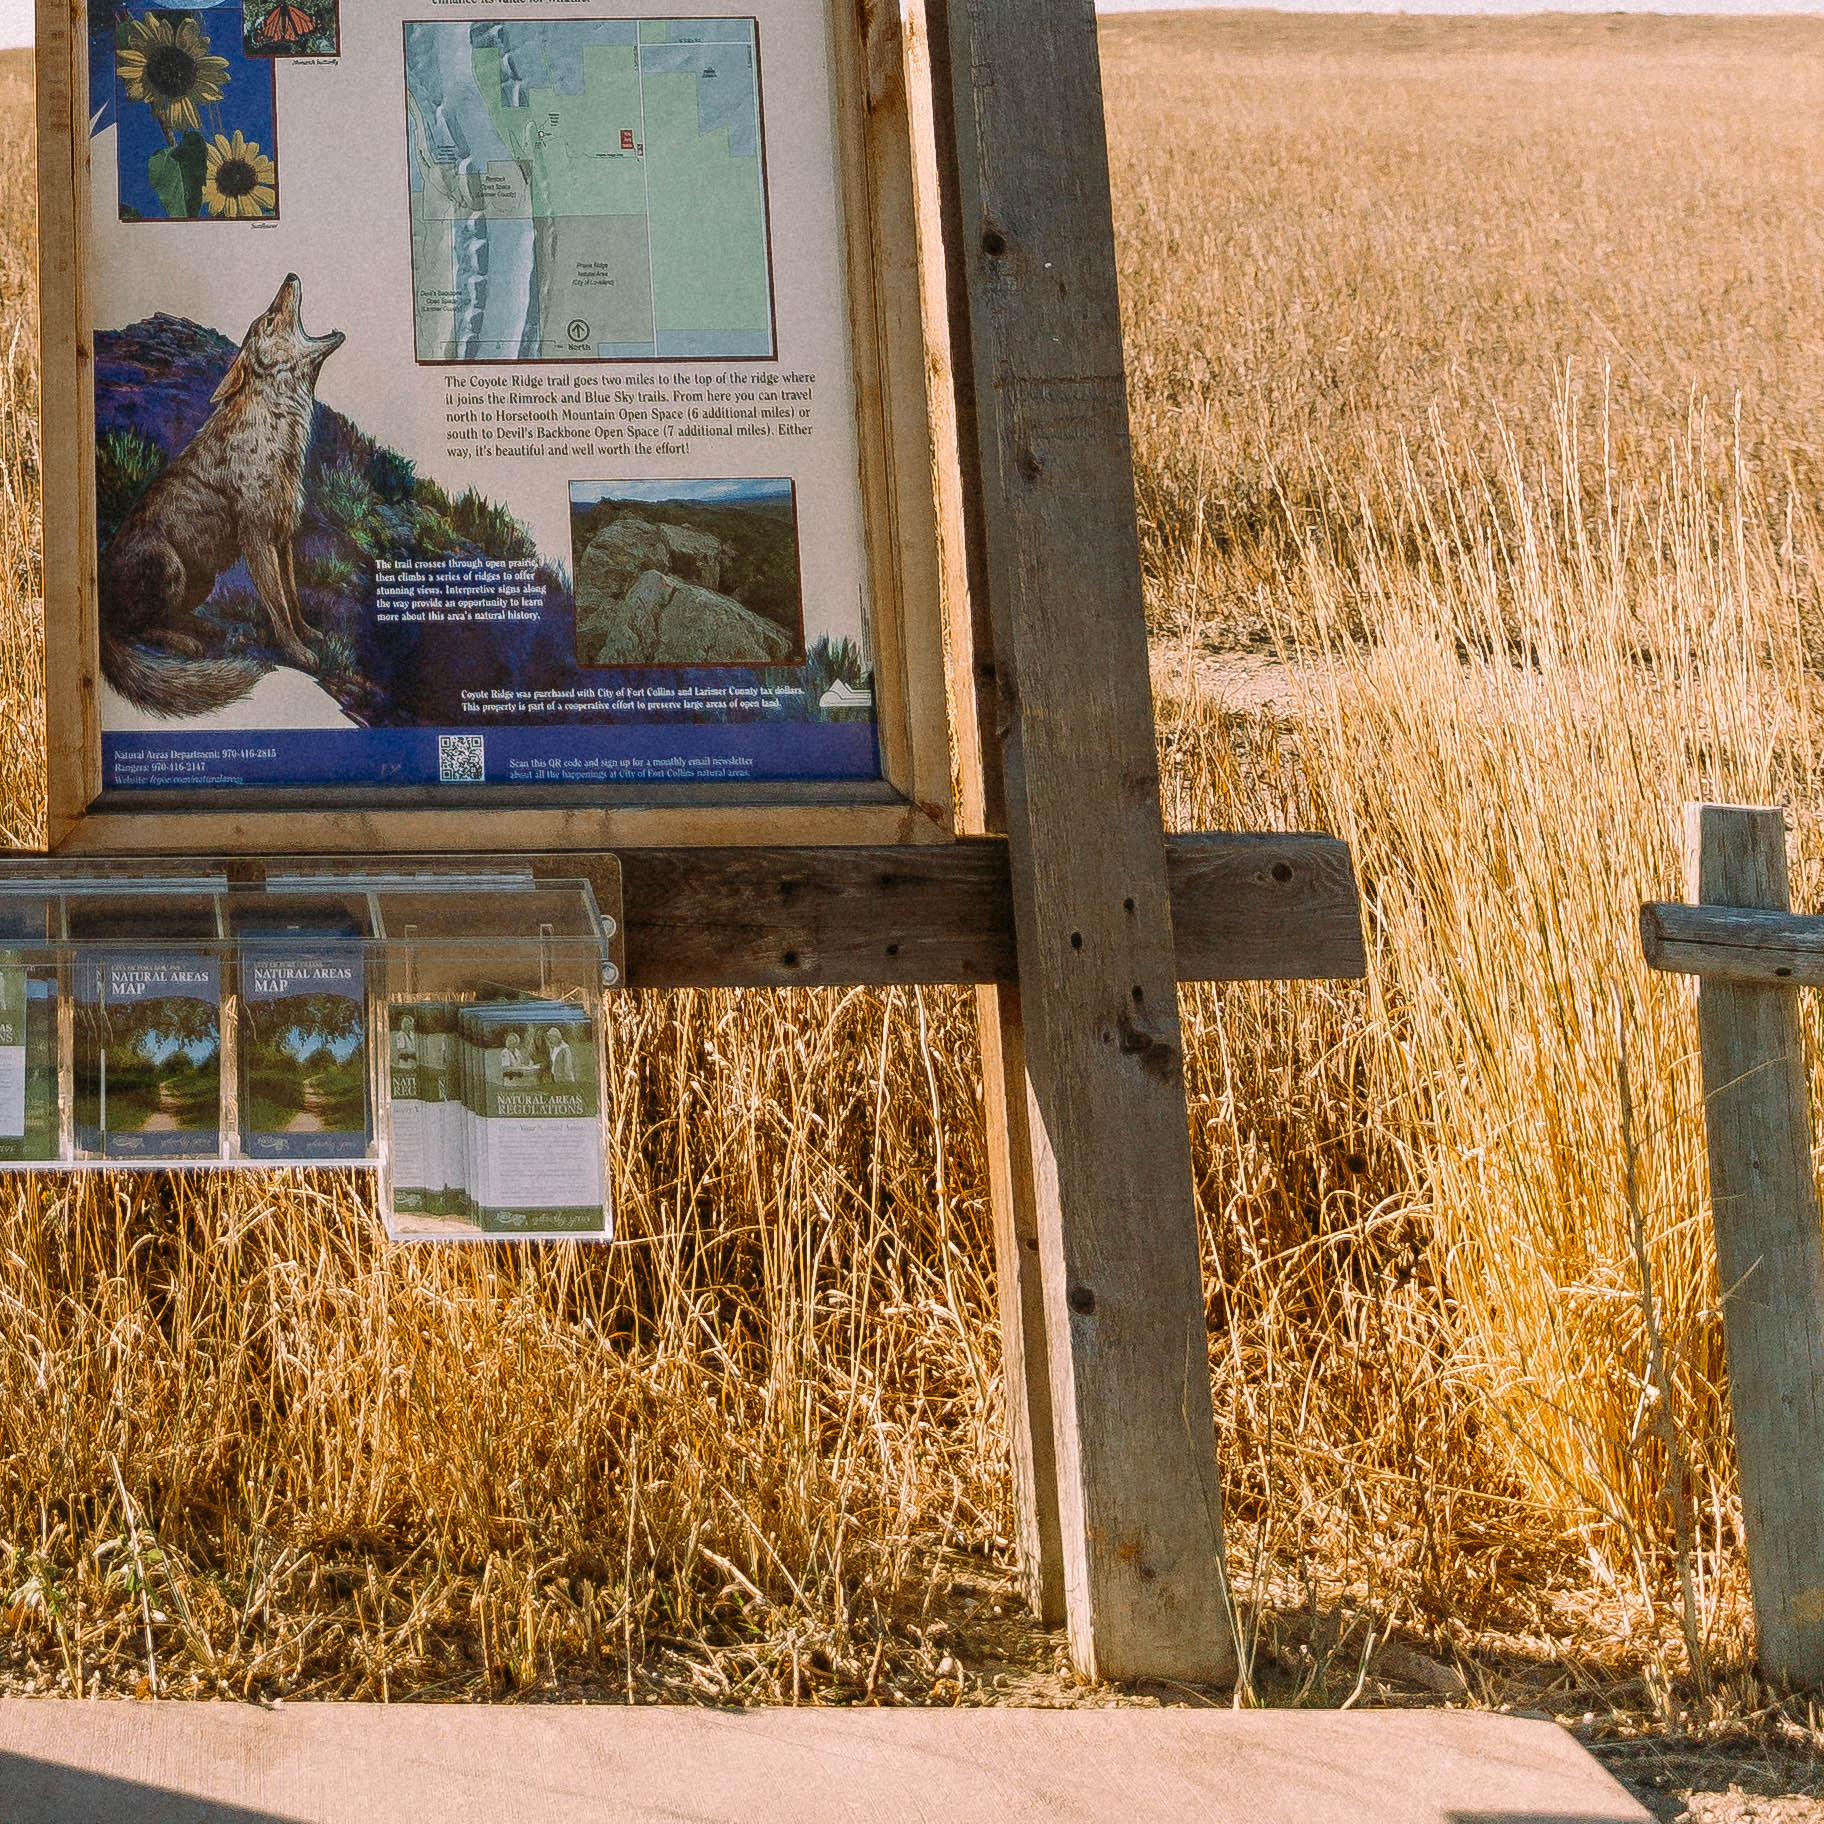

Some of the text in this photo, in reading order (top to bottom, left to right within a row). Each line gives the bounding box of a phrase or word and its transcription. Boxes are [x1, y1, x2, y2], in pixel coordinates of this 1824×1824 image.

[567, 343, 591, 351] North
[444, 370, 815, 389] The Coyote Ridge trail goes two miles to the top of the ridge where
[446, 441, 689, 459] way, it's beautiful and well worth the effort!
[376, 583, 546, 596] stunning views. Interpretive signs along
[111, 971, 209, 982] NATURAL AREAS
[254, 968, 352, 979] NATURAL AREAS
[111, 982, 146, 995] MAP
[254, 979, 289, 993] MAP
[497, 1095, 584, 1105] NATURAL AREAS
[497, 1103, 584, 1115] REGULATIONS
